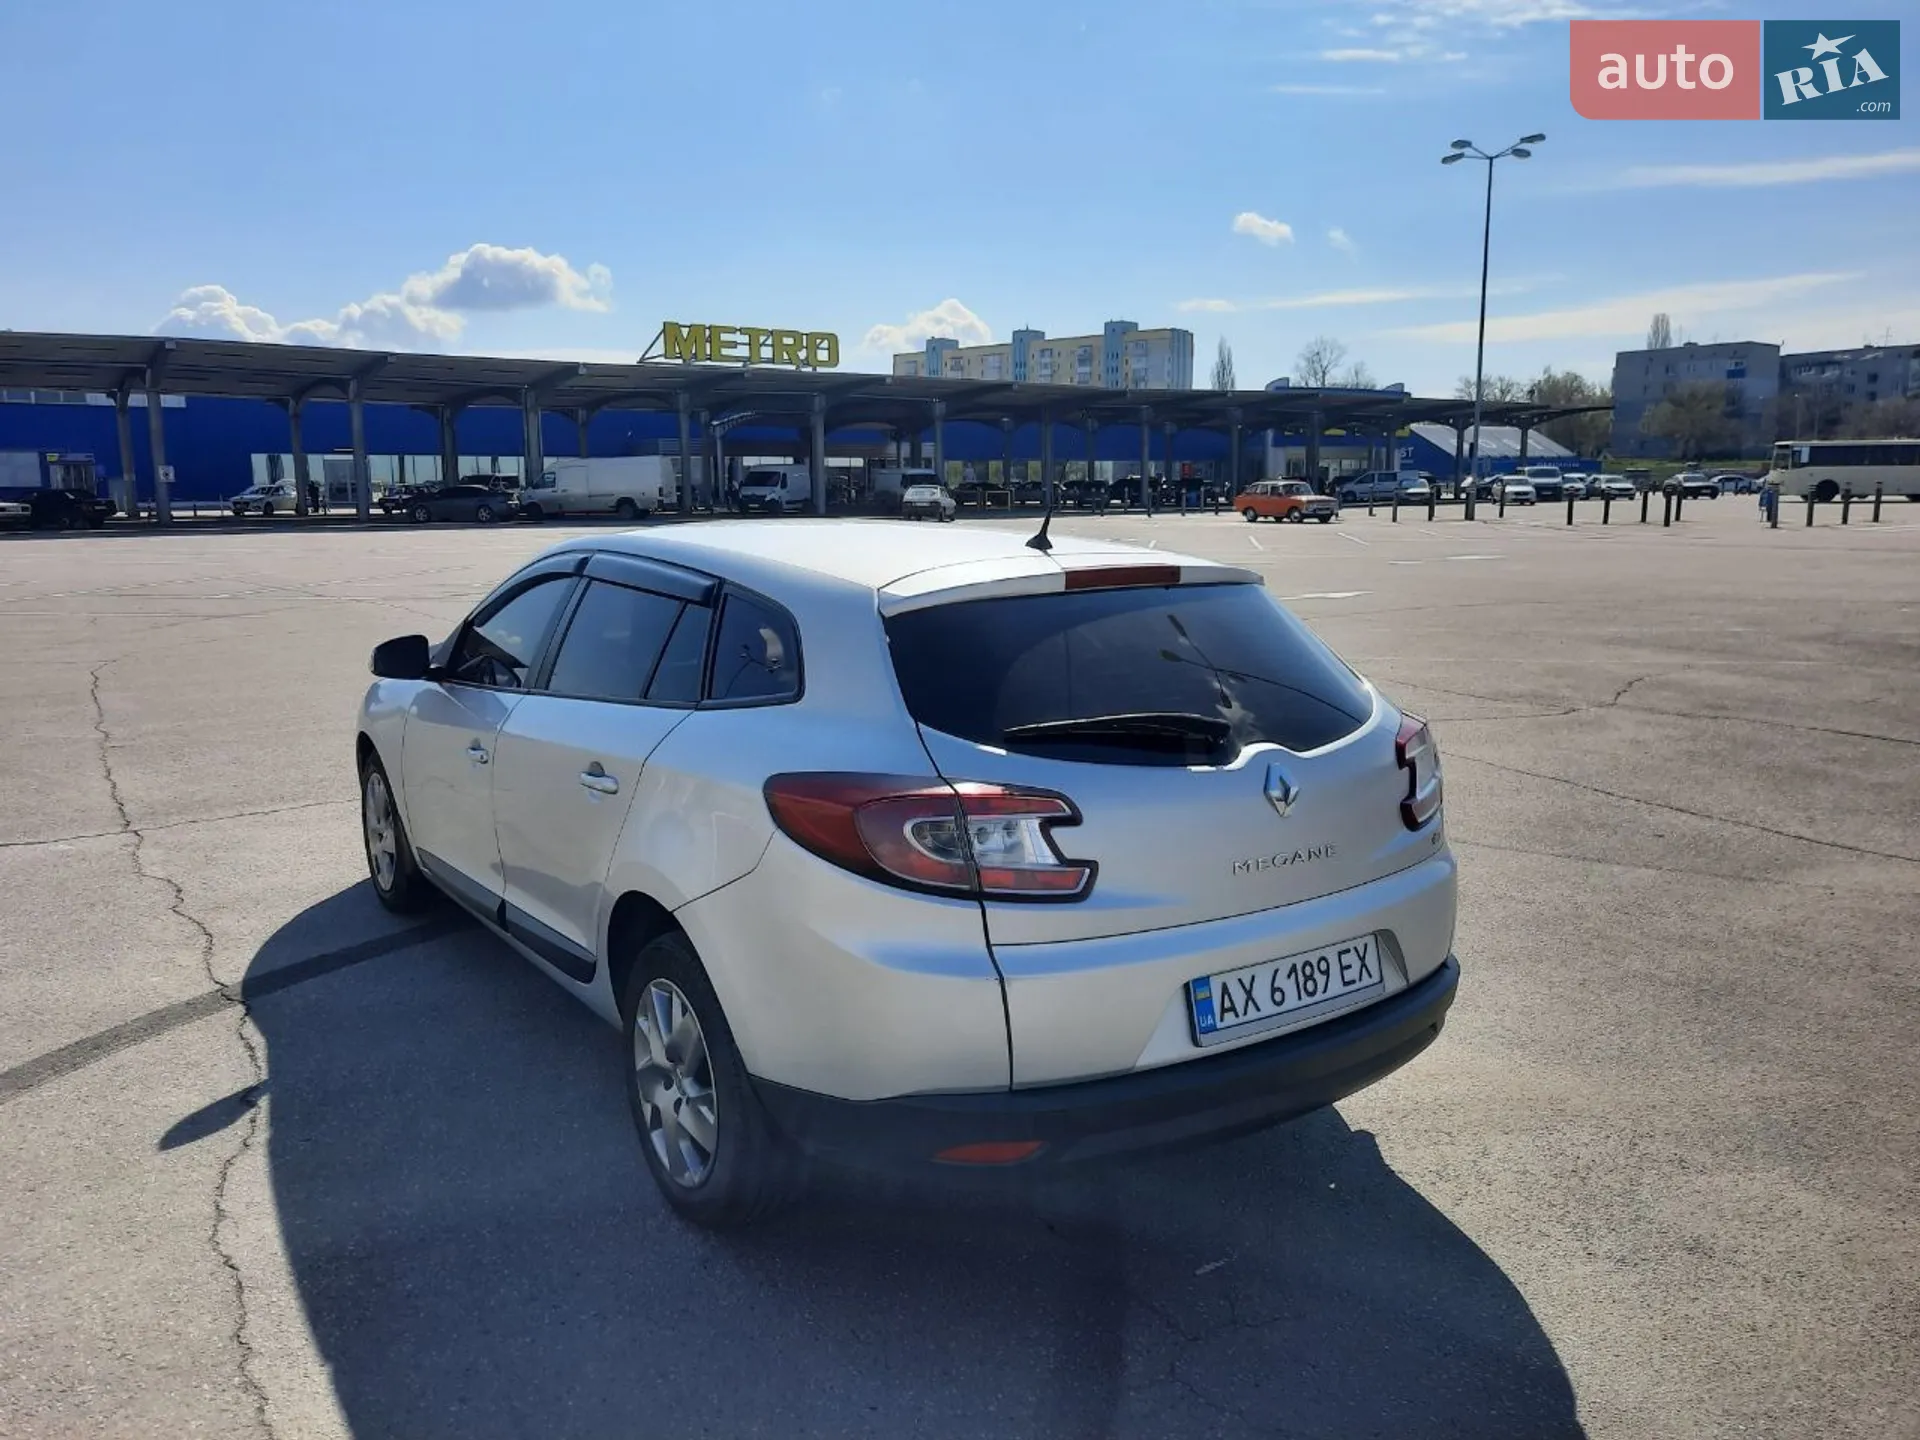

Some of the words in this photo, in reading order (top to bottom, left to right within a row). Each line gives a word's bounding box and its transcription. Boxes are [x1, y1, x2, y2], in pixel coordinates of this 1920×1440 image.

[663, 321, 840, 368] METRO
[1232, 843, 1337, 876] MEGANE
[1219, 974, 1262, 1023] AX
[1269, 956, 1331, 1007] 6189
[1337, 942, 1373, 988] EX
[1200, 1014, 1215, 1028] UA
